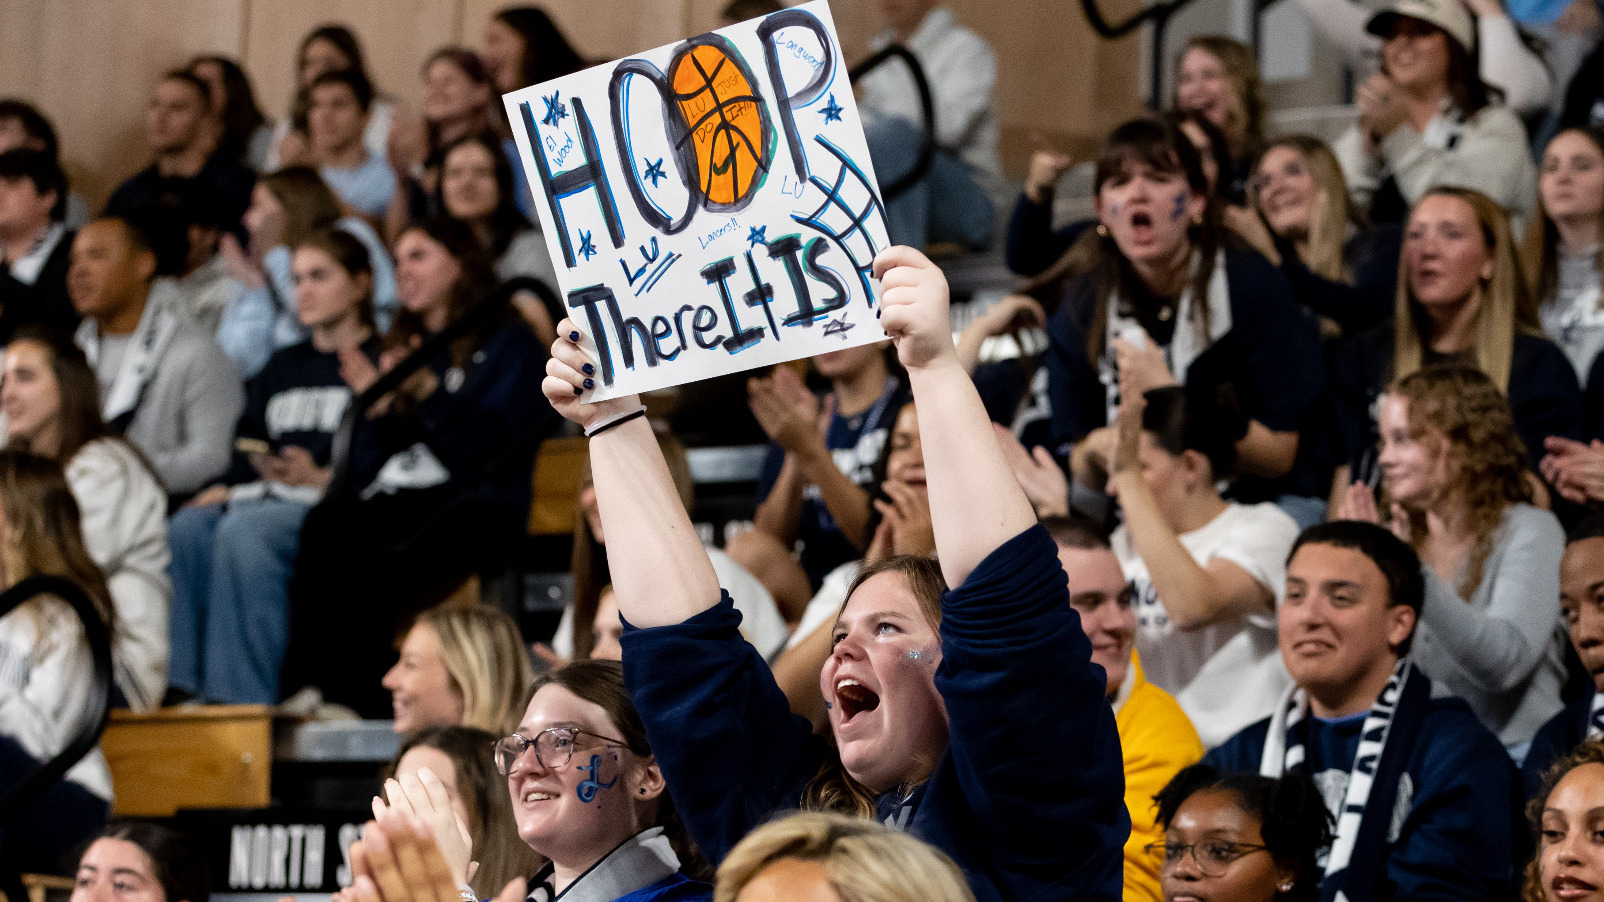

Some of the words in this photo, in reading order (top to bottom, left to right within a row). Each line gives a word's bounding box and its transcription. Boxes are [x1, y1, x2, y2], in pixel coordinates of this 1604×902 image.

[776, 31, 825, 70] Longwood
[518, 8, 837, 271] HOOP
[781, 175, 805, 200] LU
[697, 217, 741, 250] Lancers!!
[619, 235, 660, 287] LU
[567, 283, 726, 388] There
[699, 249, 780, 355] It
[228, 823, 326, 890] NORTH
